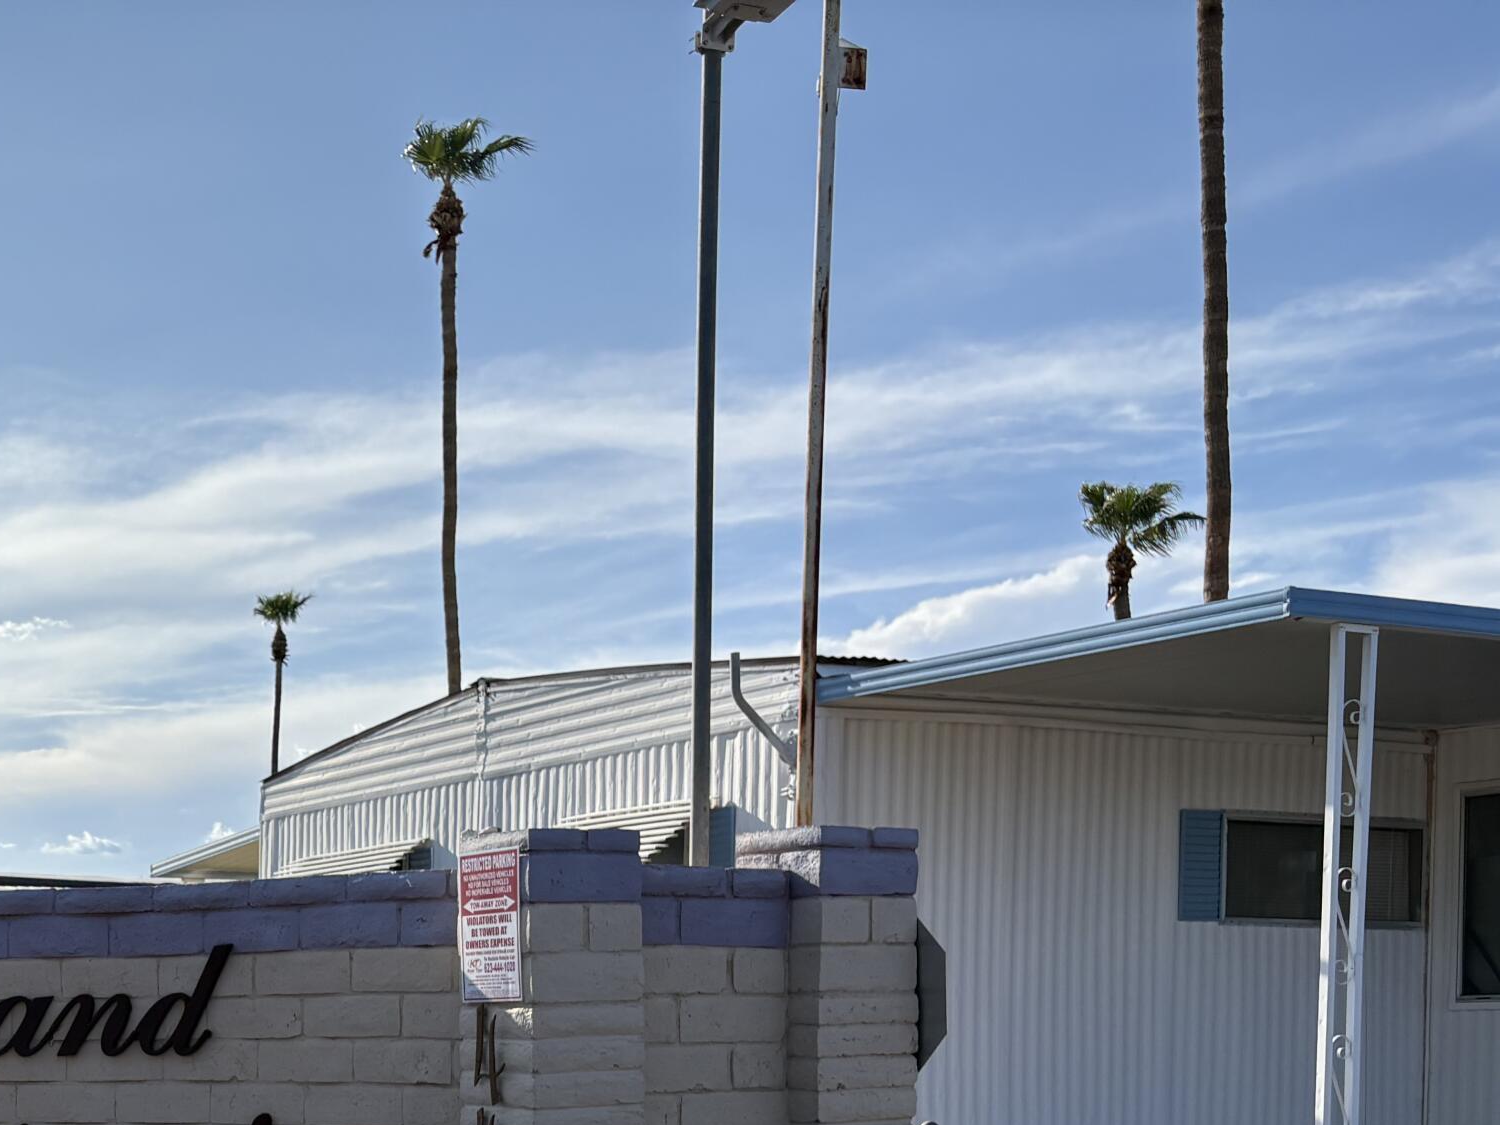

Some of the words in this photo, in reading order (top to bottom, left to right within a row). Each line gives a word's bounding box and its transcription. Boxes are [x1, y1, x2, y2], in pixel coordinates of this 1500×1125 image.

[462, 855, 491, 874] RESTRICTED
[492, 852, 515, 869] PARKING
[467, 914, 497, 926] VIOLATORS
[498, 913, 512, 923] WILL
[471, 928, 478, 937] BE
[479, 926, 499, 937] TOWED
[501, 926, 507, 935] AT
[466, 939, 489, 949] OWNERS
[490, 937, 514, 949] EXPENSE
